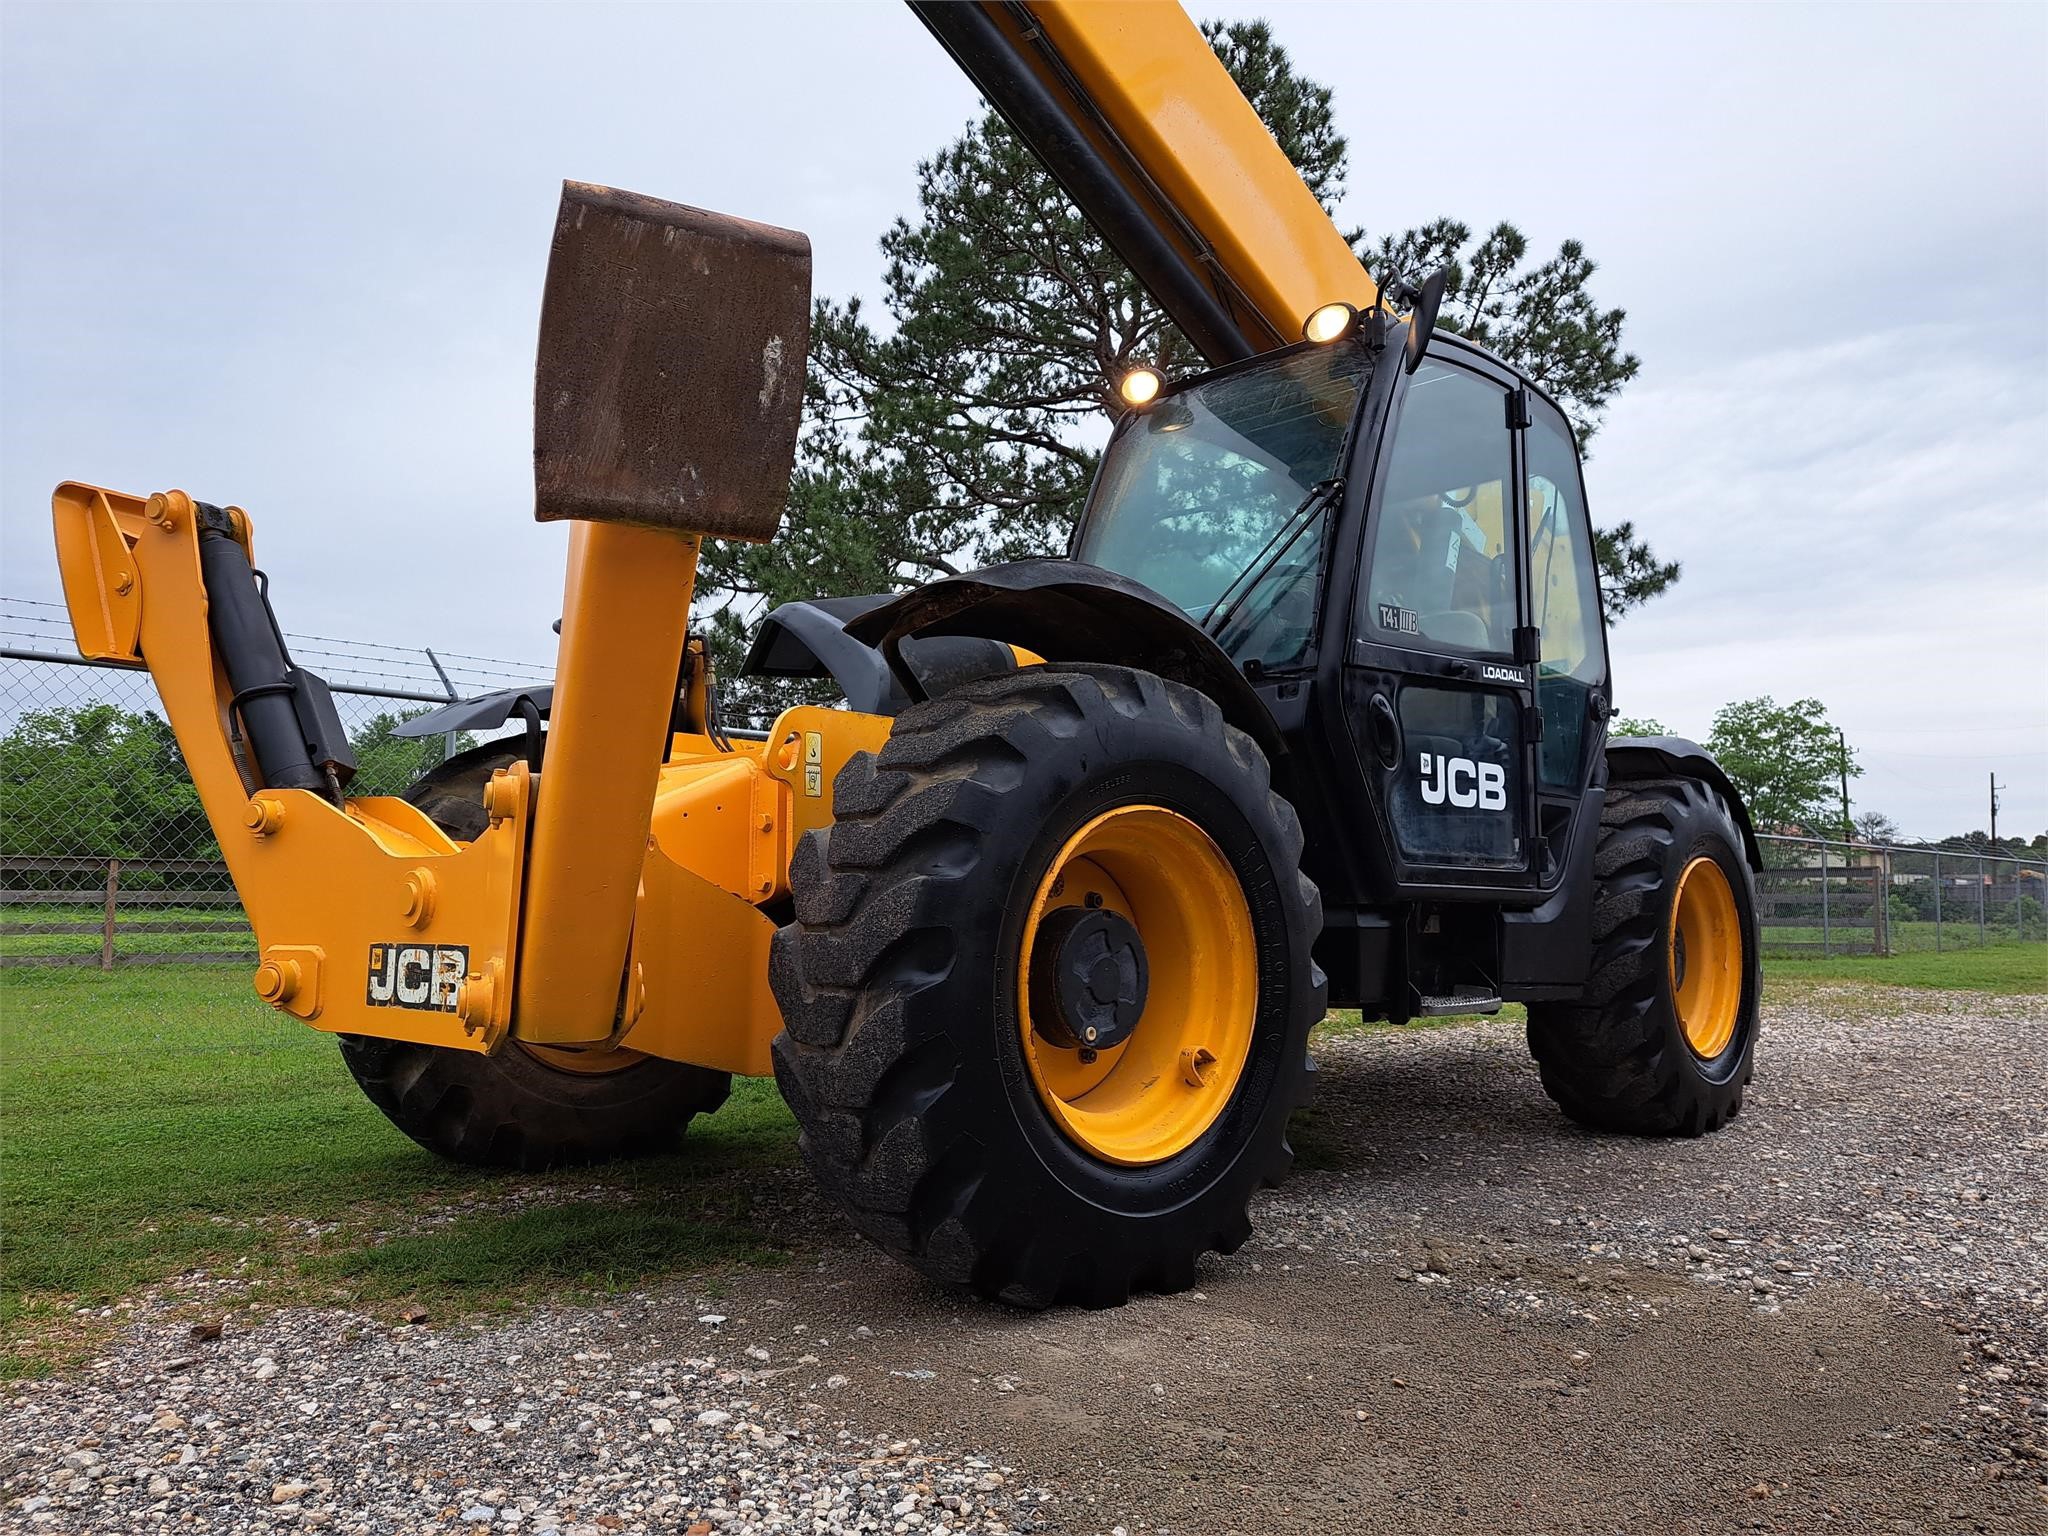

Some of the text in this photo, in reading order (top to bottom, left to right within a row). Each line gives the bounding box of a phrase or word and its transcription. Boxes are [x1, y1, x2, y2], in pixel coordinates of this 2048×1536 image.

[1380, 606, 1399, 629] T4i
[1482, 665, 1526, 683] LOADALL
[1420, 752, 1507, 811] JCB
[369, 947, 466, 1006] JCB
